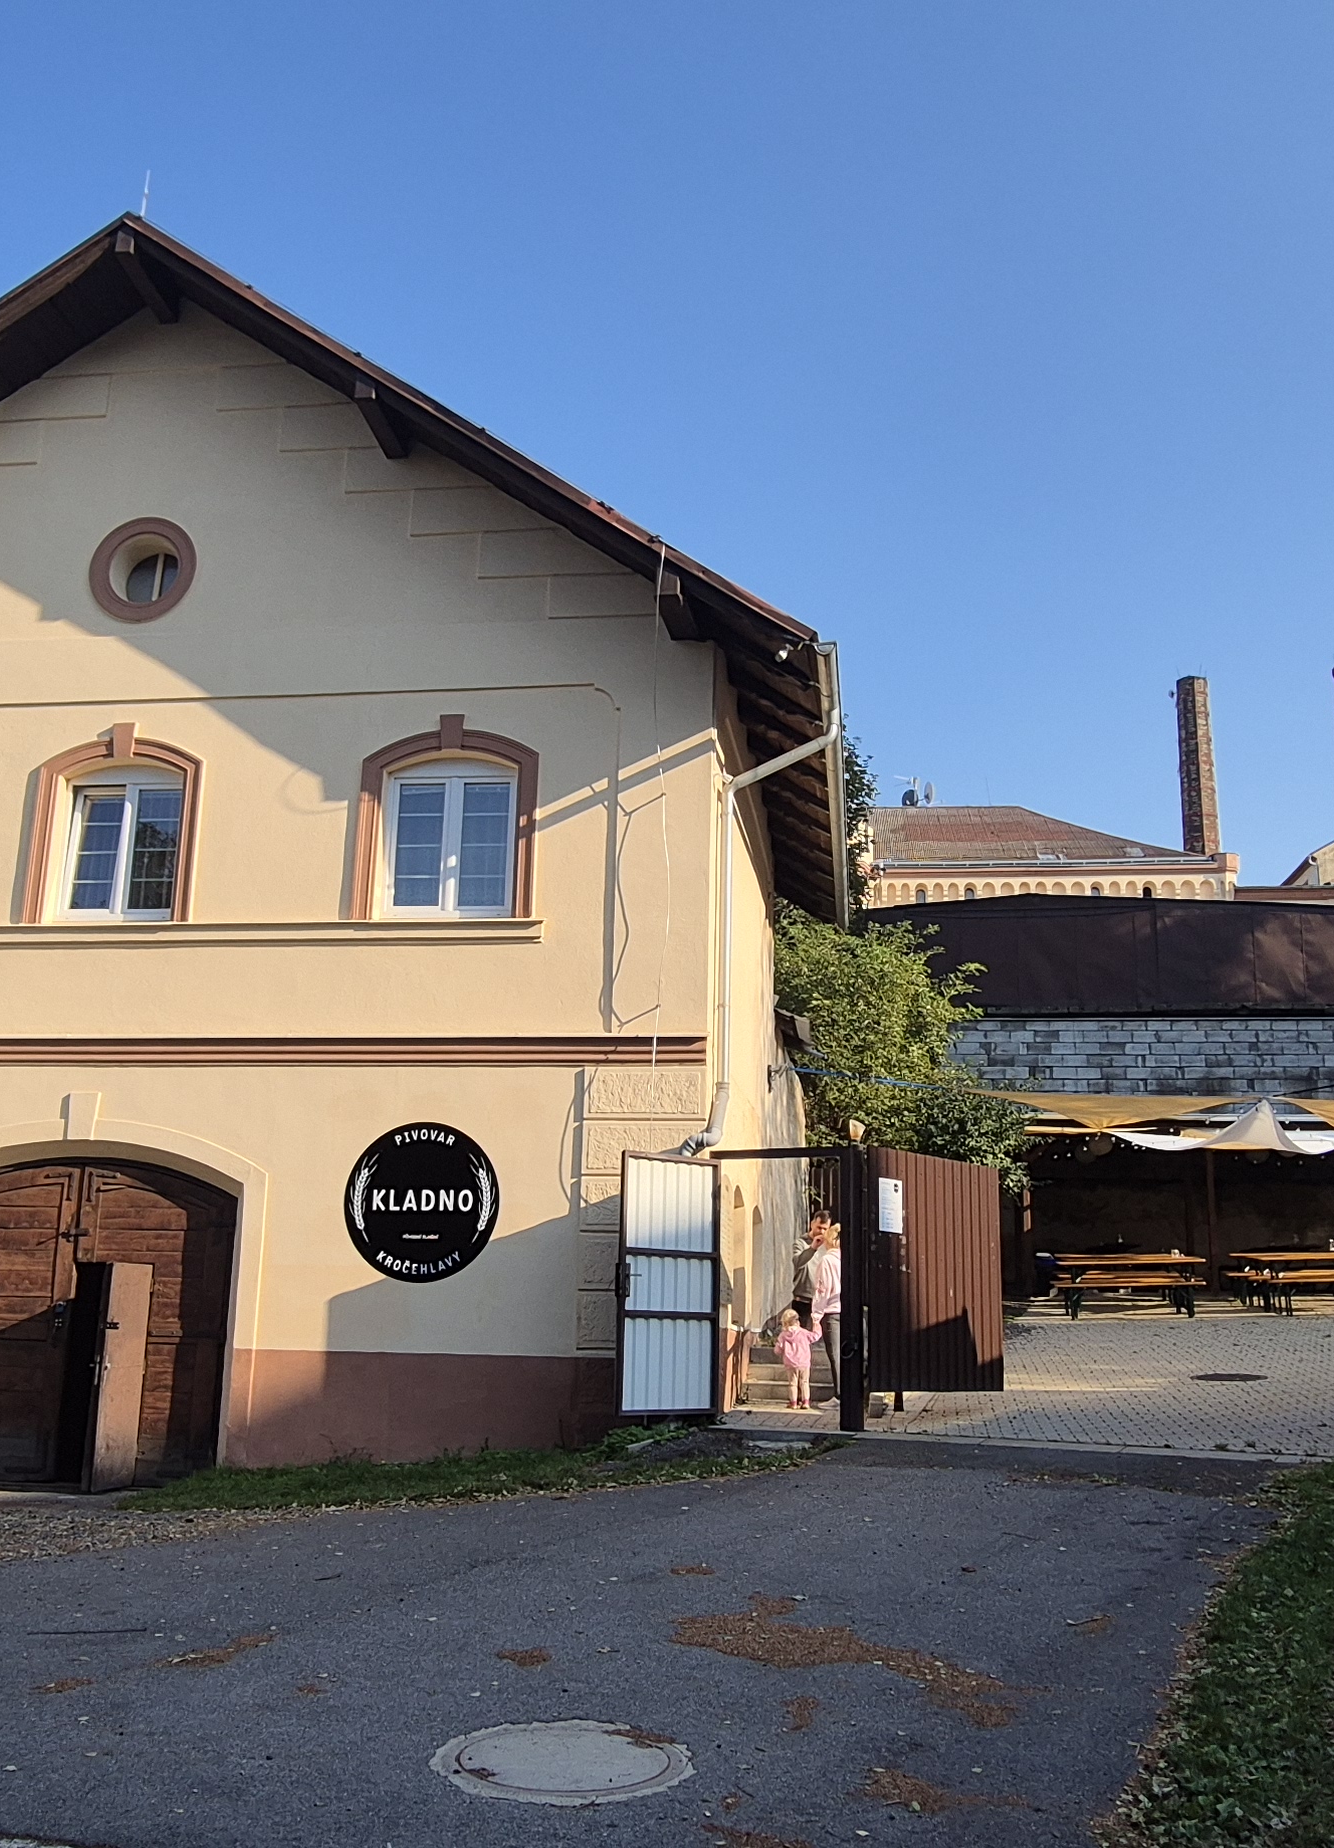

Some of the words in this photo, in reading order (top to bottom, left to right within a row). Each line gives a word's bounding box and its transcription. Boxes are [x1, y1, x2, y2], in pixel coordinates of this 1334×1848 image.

[394, 1129, 456, 1146] PIVOVAR
[372, 1189, 474, 1212] KLADNO
[376, 1250, 461, 1275] KROČEHLAVY
